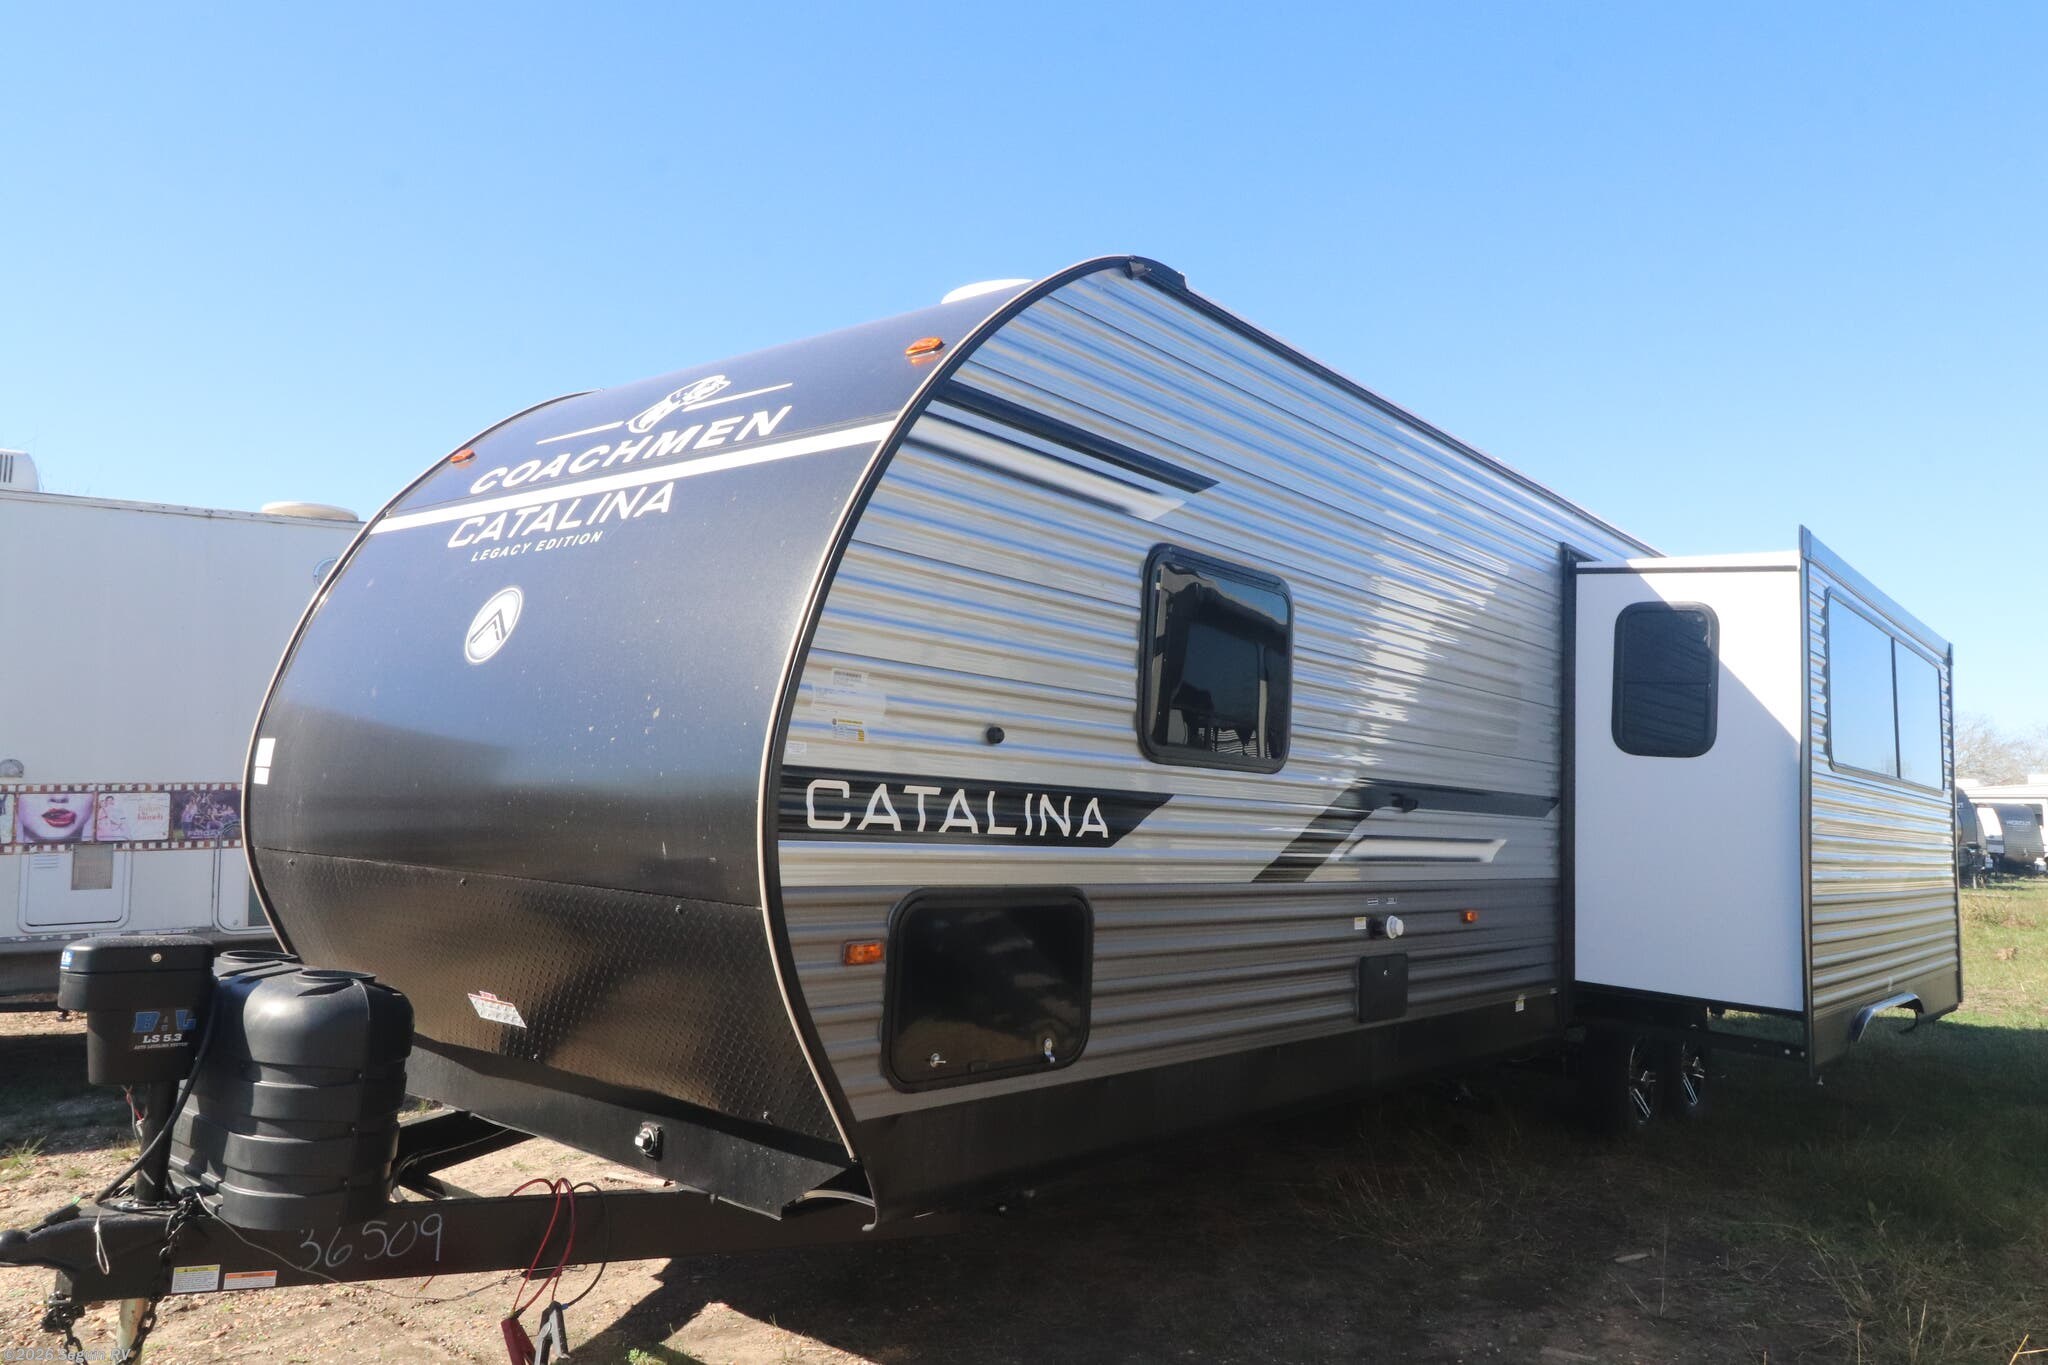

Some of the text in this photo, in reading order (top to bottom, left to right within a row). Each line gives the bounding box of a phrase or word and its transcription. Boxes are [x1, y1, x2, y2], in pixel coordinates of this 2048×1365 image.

[470, 405, 792, 494] COACHMEN
[447, 481, 674, 547] CATALINA
[470, 530, 604, 562] LEGACY EDITION
[806, 779, 1109, 838] CATALINA
[143, 1034, 160, 1044] LS
